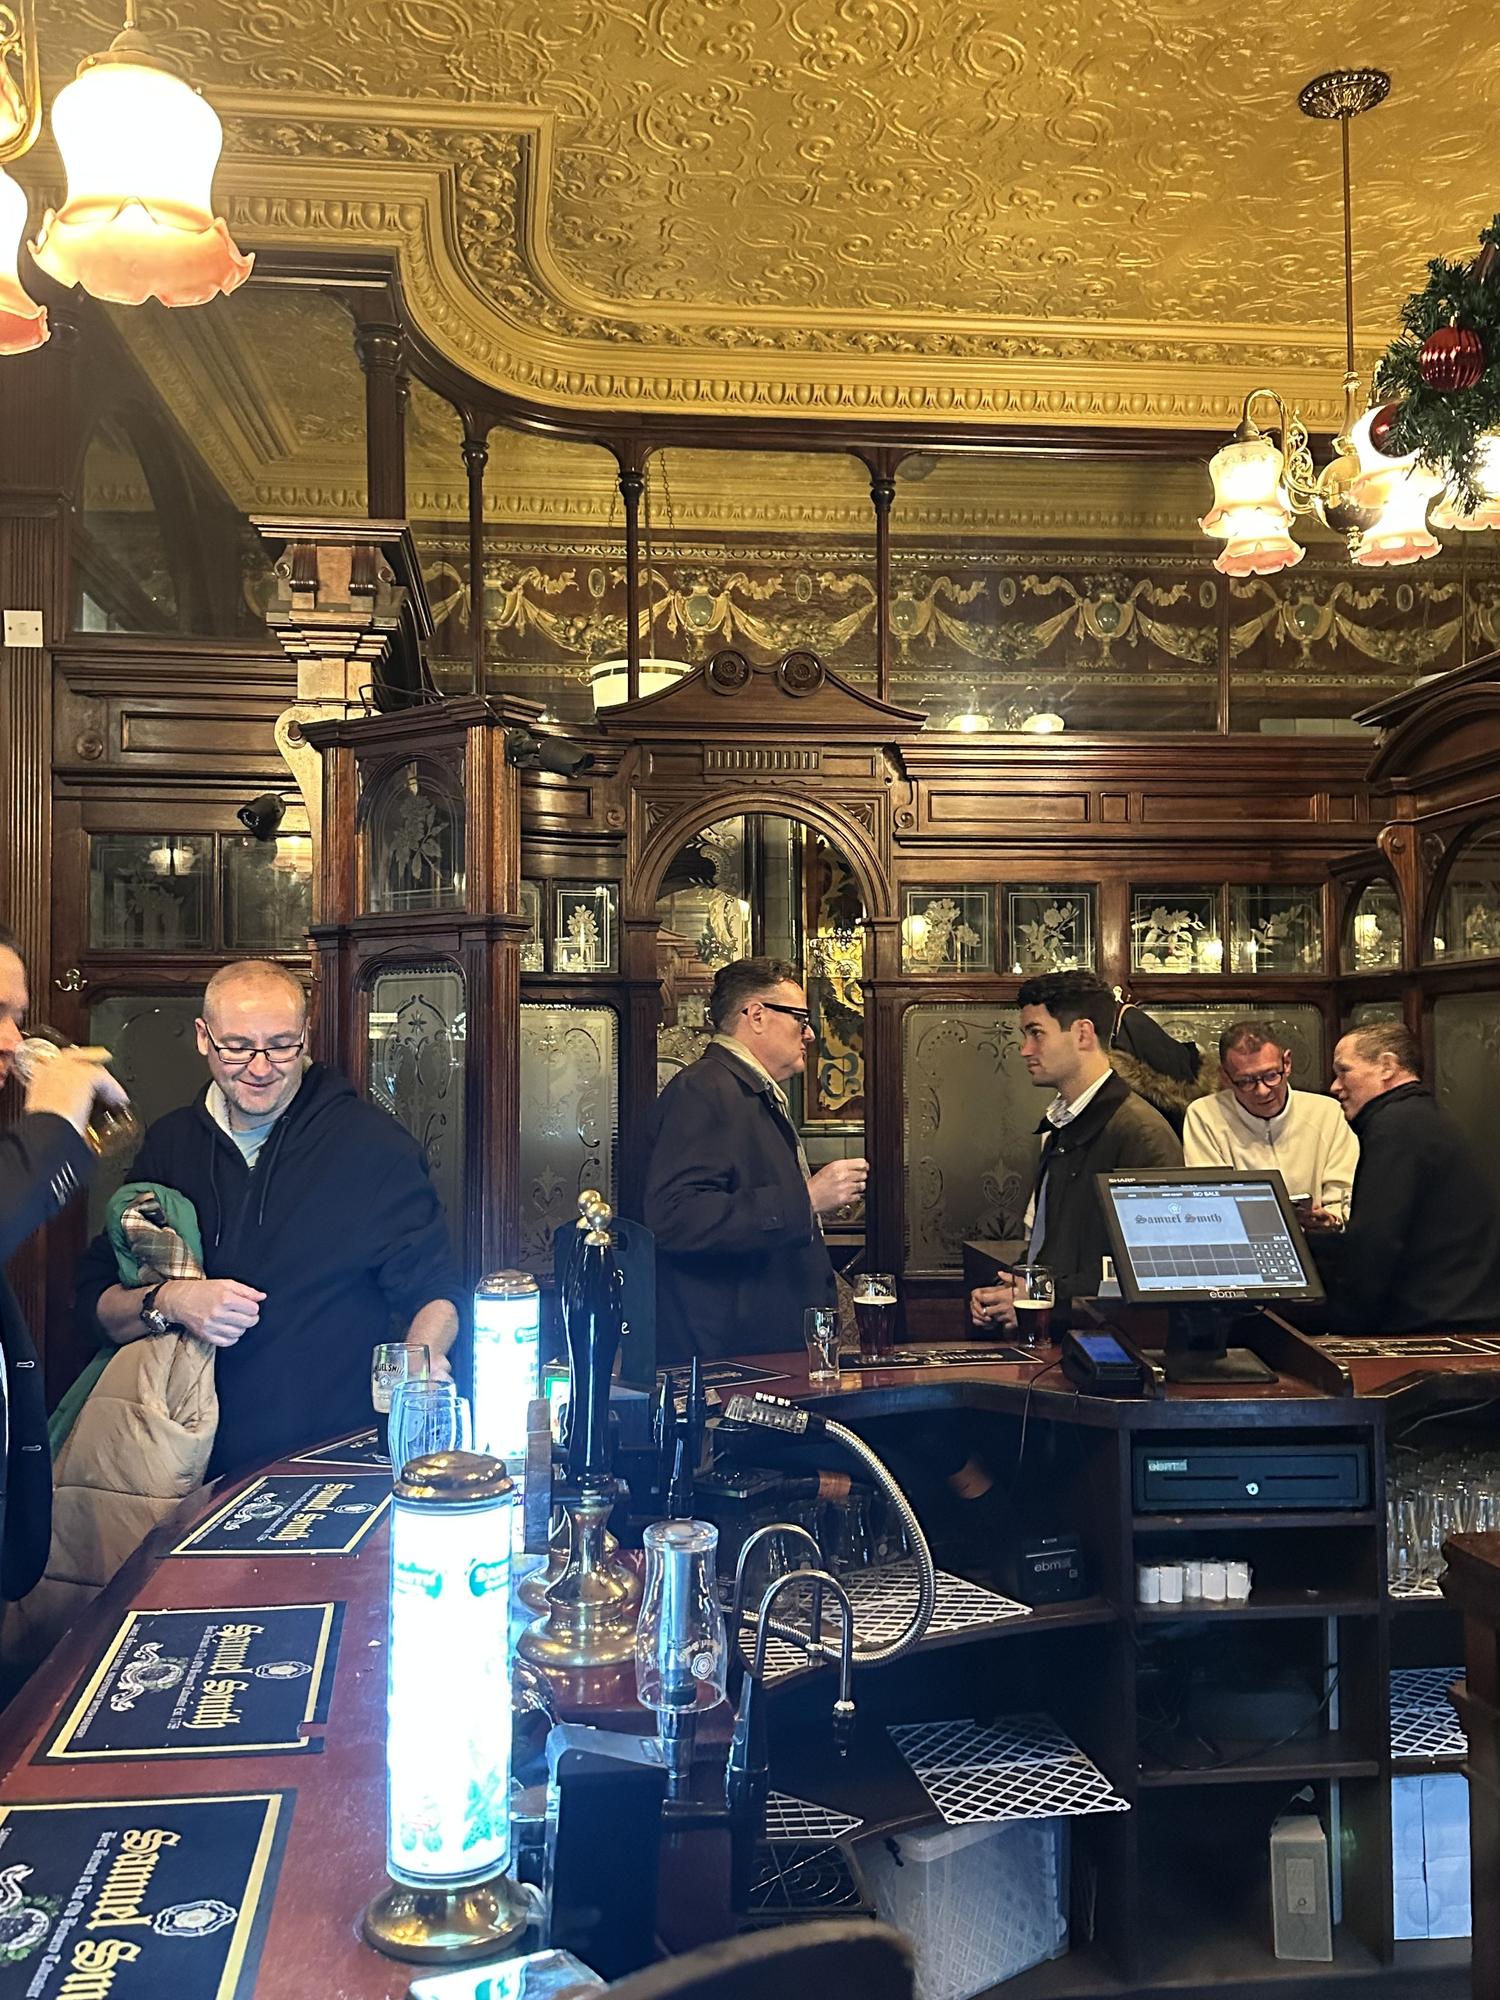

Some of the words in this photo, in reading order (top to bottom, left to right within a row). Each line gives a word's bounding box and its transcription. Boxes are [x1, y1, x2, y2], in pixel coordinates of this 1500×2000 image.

[1135, 1213, 1182, 1225] Samuel
[1184, 1212, 1222, 1224] Smith
[302, 1483, 355, 1511] Samuel
[268, 1512, 327, 1541] Smith
[208, 1624, 265, 1675] Samuel
[182, 1679, 250, 1729] Smith
[86, 1829, 182, 1931] Samuel
